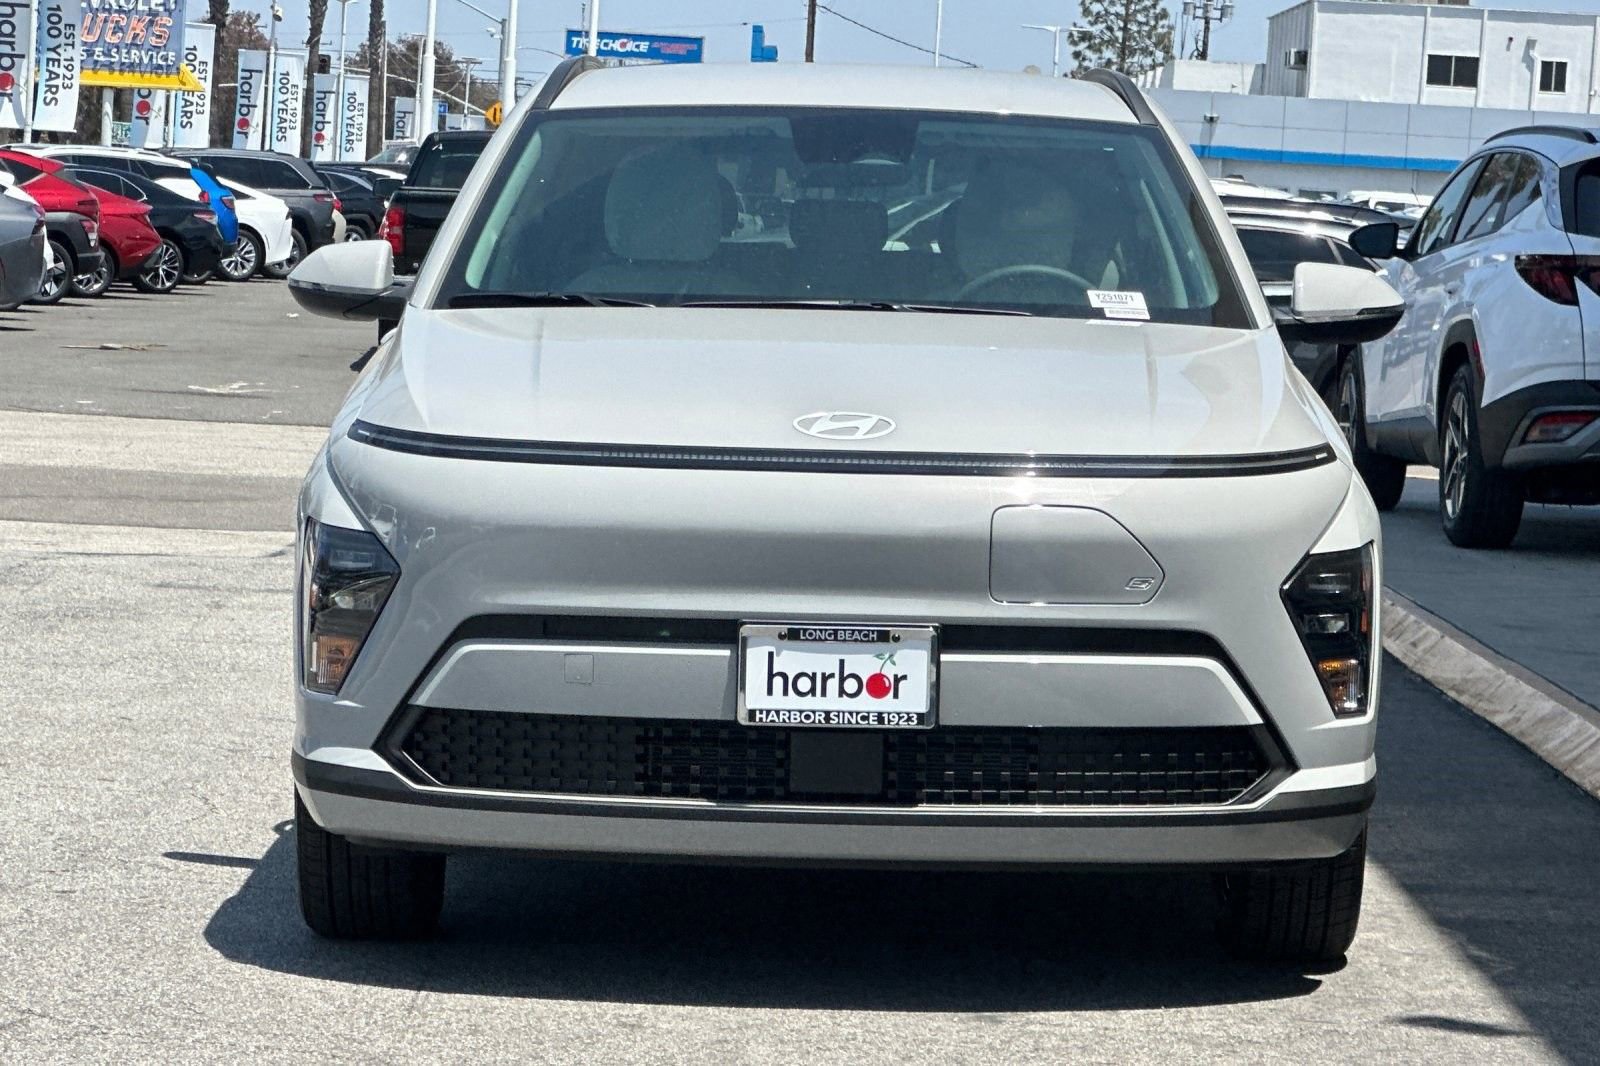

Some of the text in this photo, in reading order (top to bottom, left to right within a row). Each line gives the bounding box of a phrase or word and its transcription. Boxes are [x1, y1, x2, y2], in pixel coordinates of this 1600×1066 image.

[43, 4, 62, 107] 100 YEARS
[62, 23, 75, 90] EST. 1923
[110, 48, 176, 65] SERVICE
[195, 90, 206, 115] 923
[236, 68, 263, 139] harbor
[276, 70, 290, 142] 100 YEARS
[289, 107, 297, 131] 1923
[314, 90, 336, 152] harbor
[344, 91, 357, 152] 100 YEARS
[356, 122, 364, 142] 1923
[800, 629, 878, 641] LONG BEACH
[766, 651, 908, 700] harbor
[755, 710, 918, 726] HARBOR SINCE 1923
